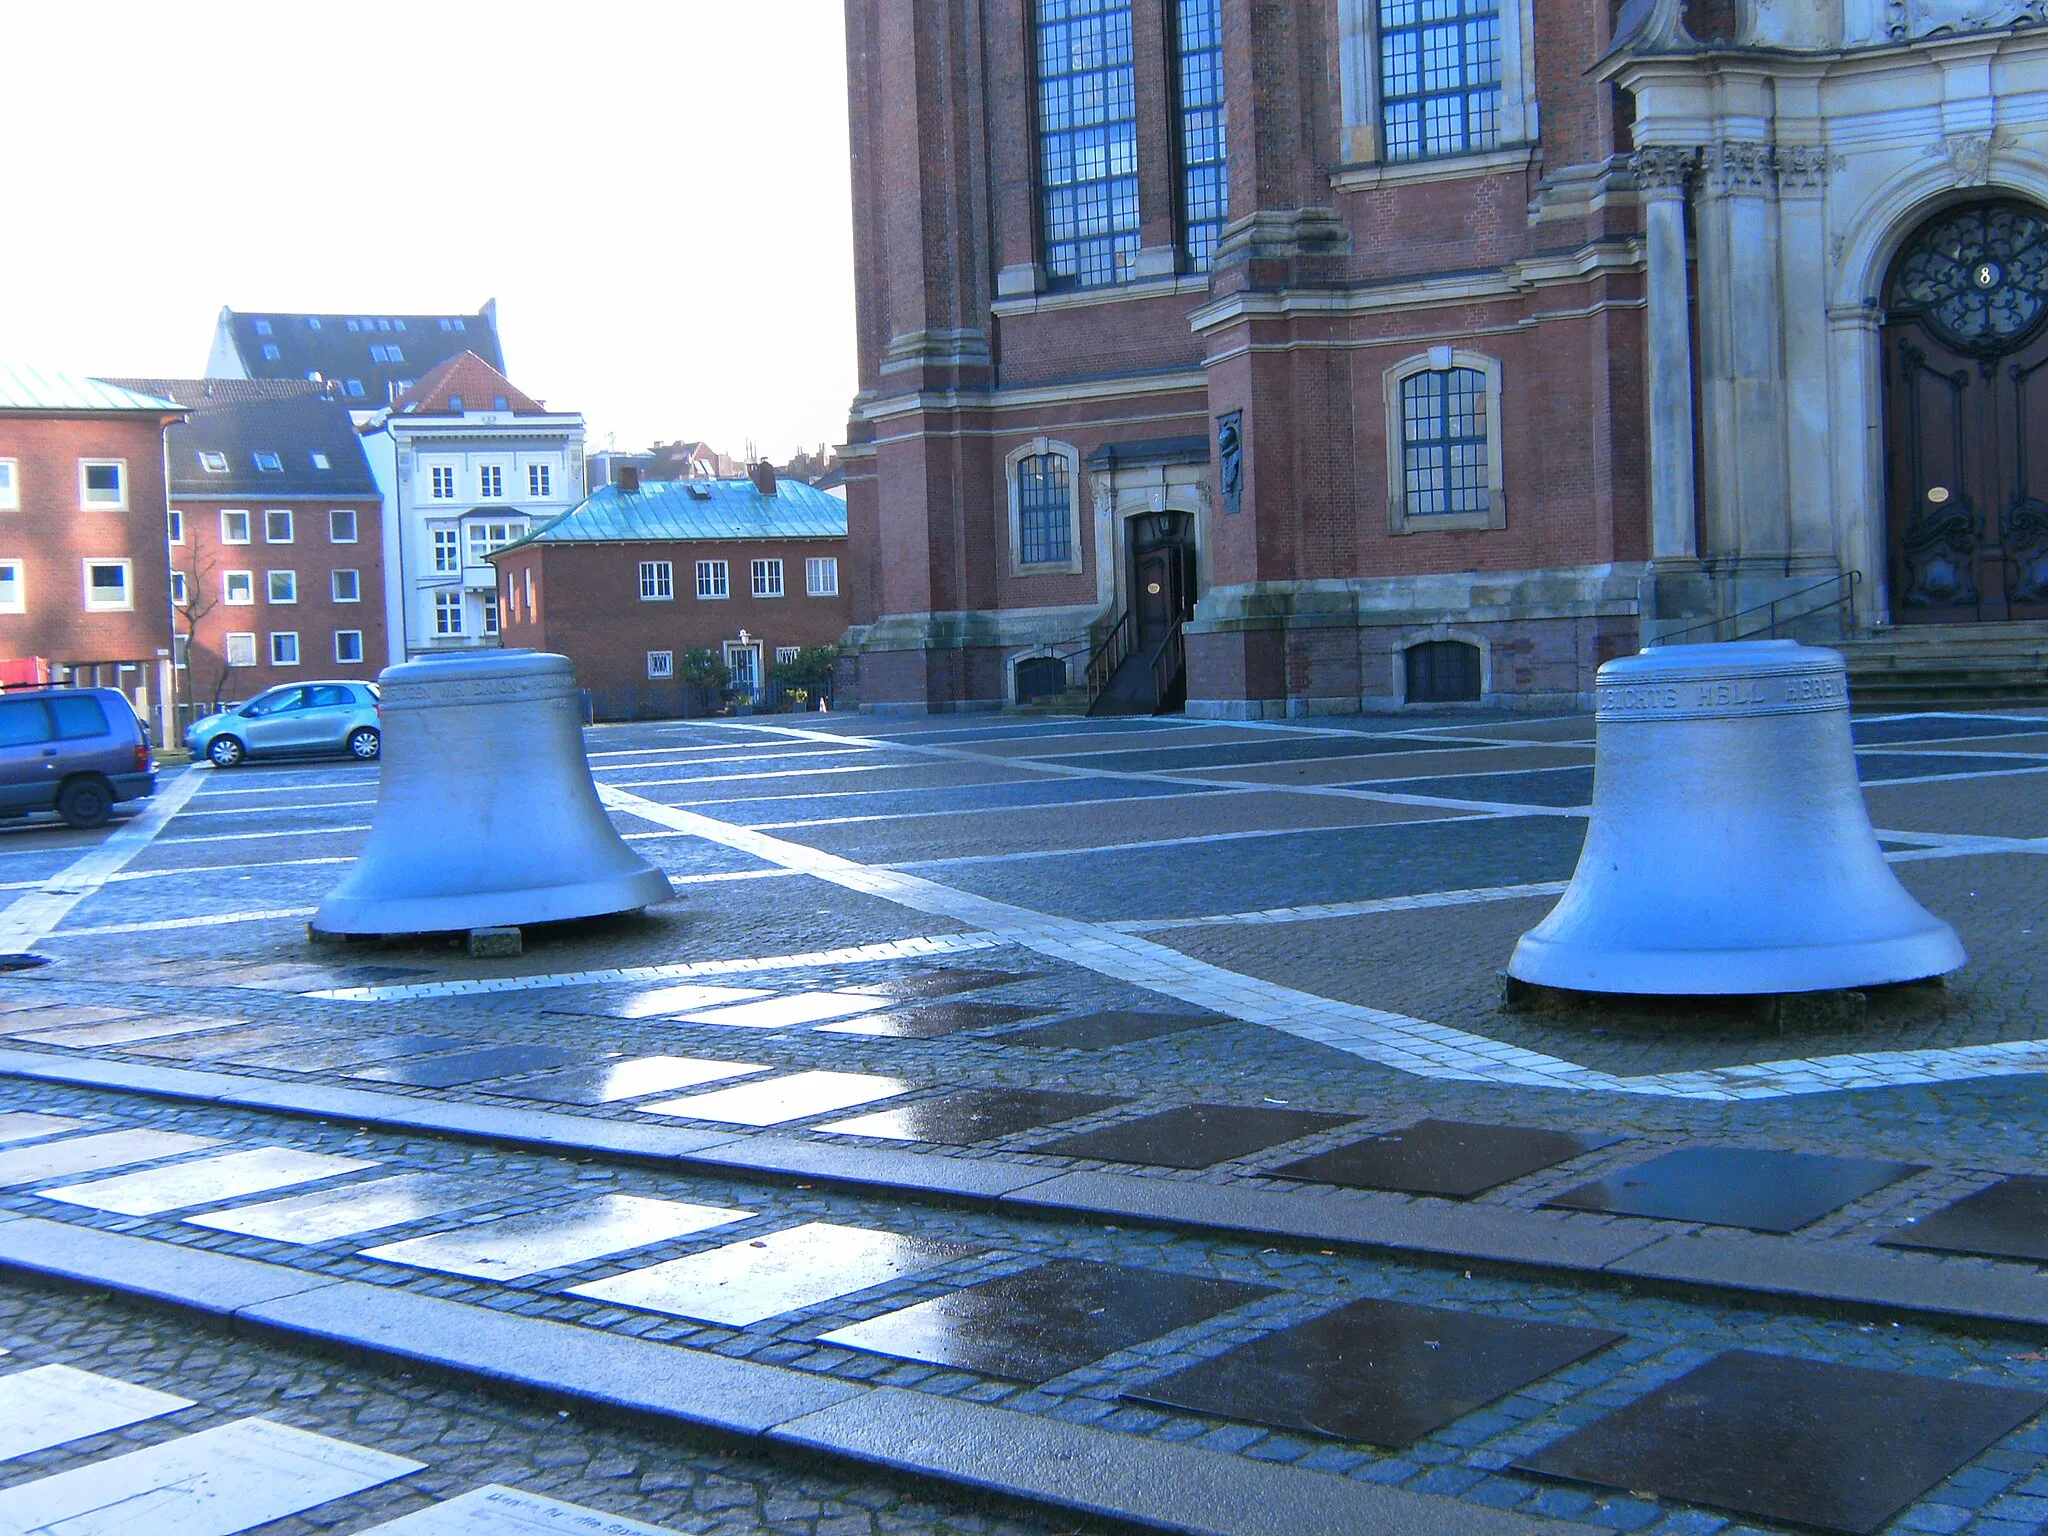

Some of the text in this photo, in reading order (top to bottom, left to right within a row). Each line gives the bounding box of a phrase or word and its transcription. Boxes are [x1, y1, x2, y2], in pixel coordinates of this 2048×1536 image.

[1980, 266, 1991, 284] 8
[1154, 493, 1160, 503] 7
[1699, 683, 1767, 707] HELL
